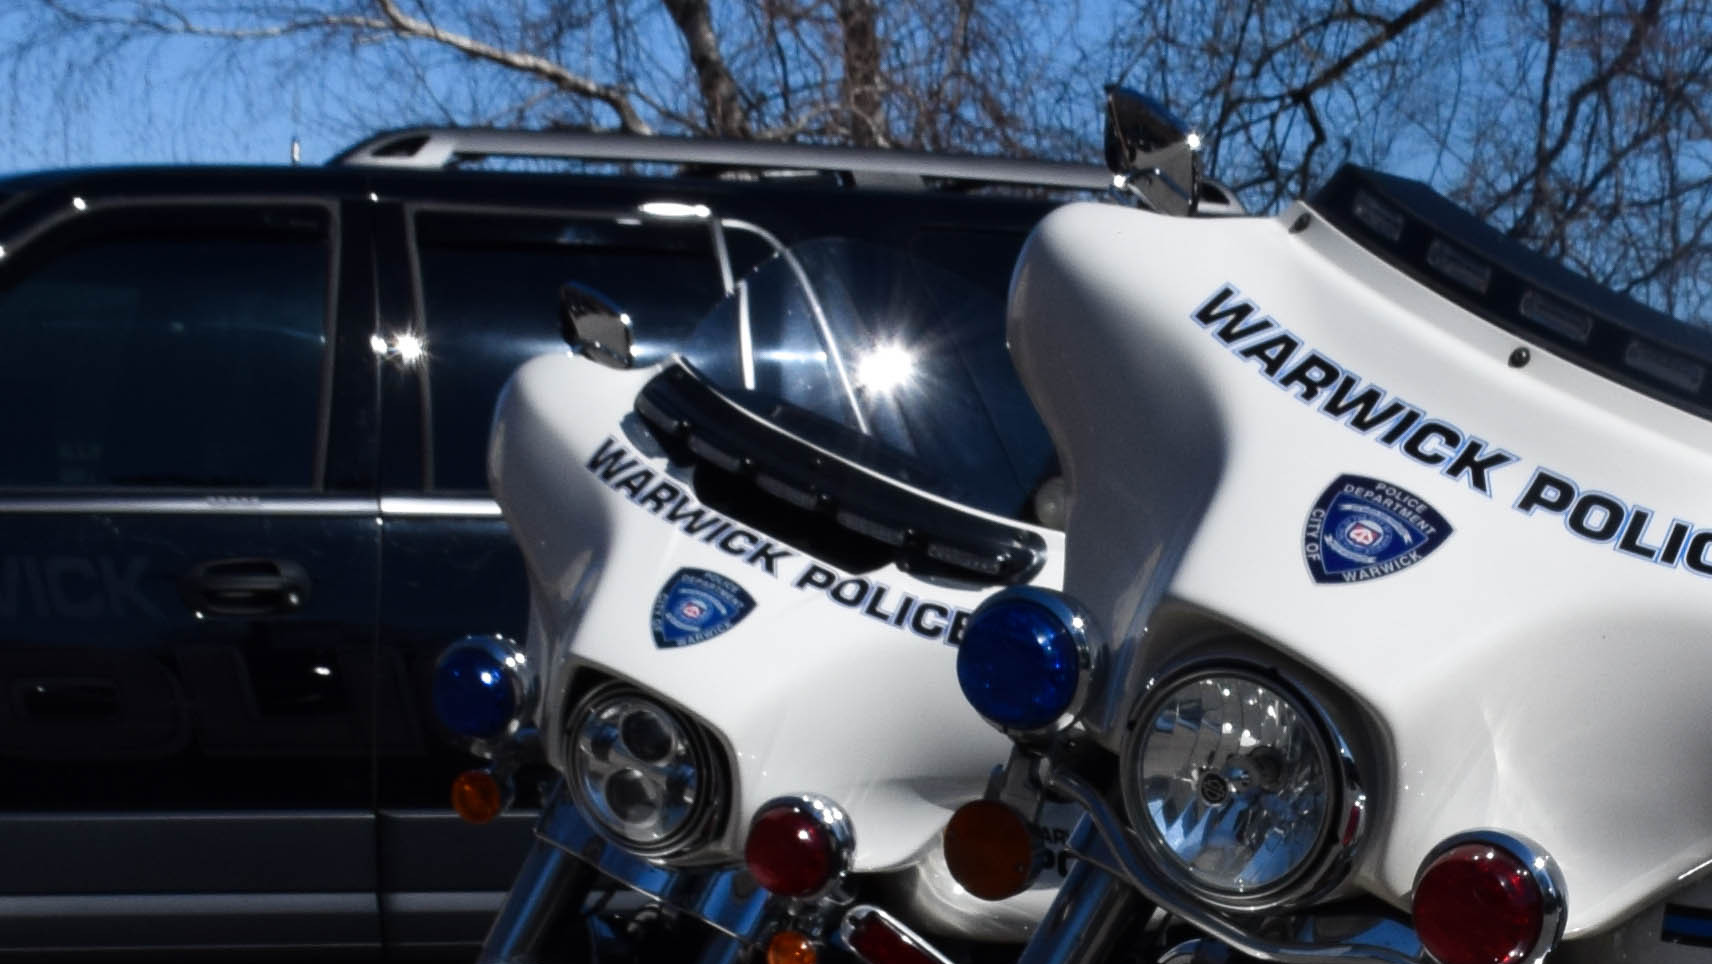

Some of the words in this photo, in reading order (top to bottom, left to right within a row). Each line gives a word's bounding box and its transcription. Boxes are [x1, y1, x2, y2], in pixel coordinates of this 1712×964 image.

[1193, 285, 1516, 495] WARWICK
[588, 437, 792, 577] WARWICK
[1343, 483, 1437, 535] DEPARTMENT
[1375, 482, 1428, 514] POLICE
[1306, 508, 1325, 541] CITY
[1306, 544, 1321, 561] OF
[1342, 551, 1422, 582] WARWICK
